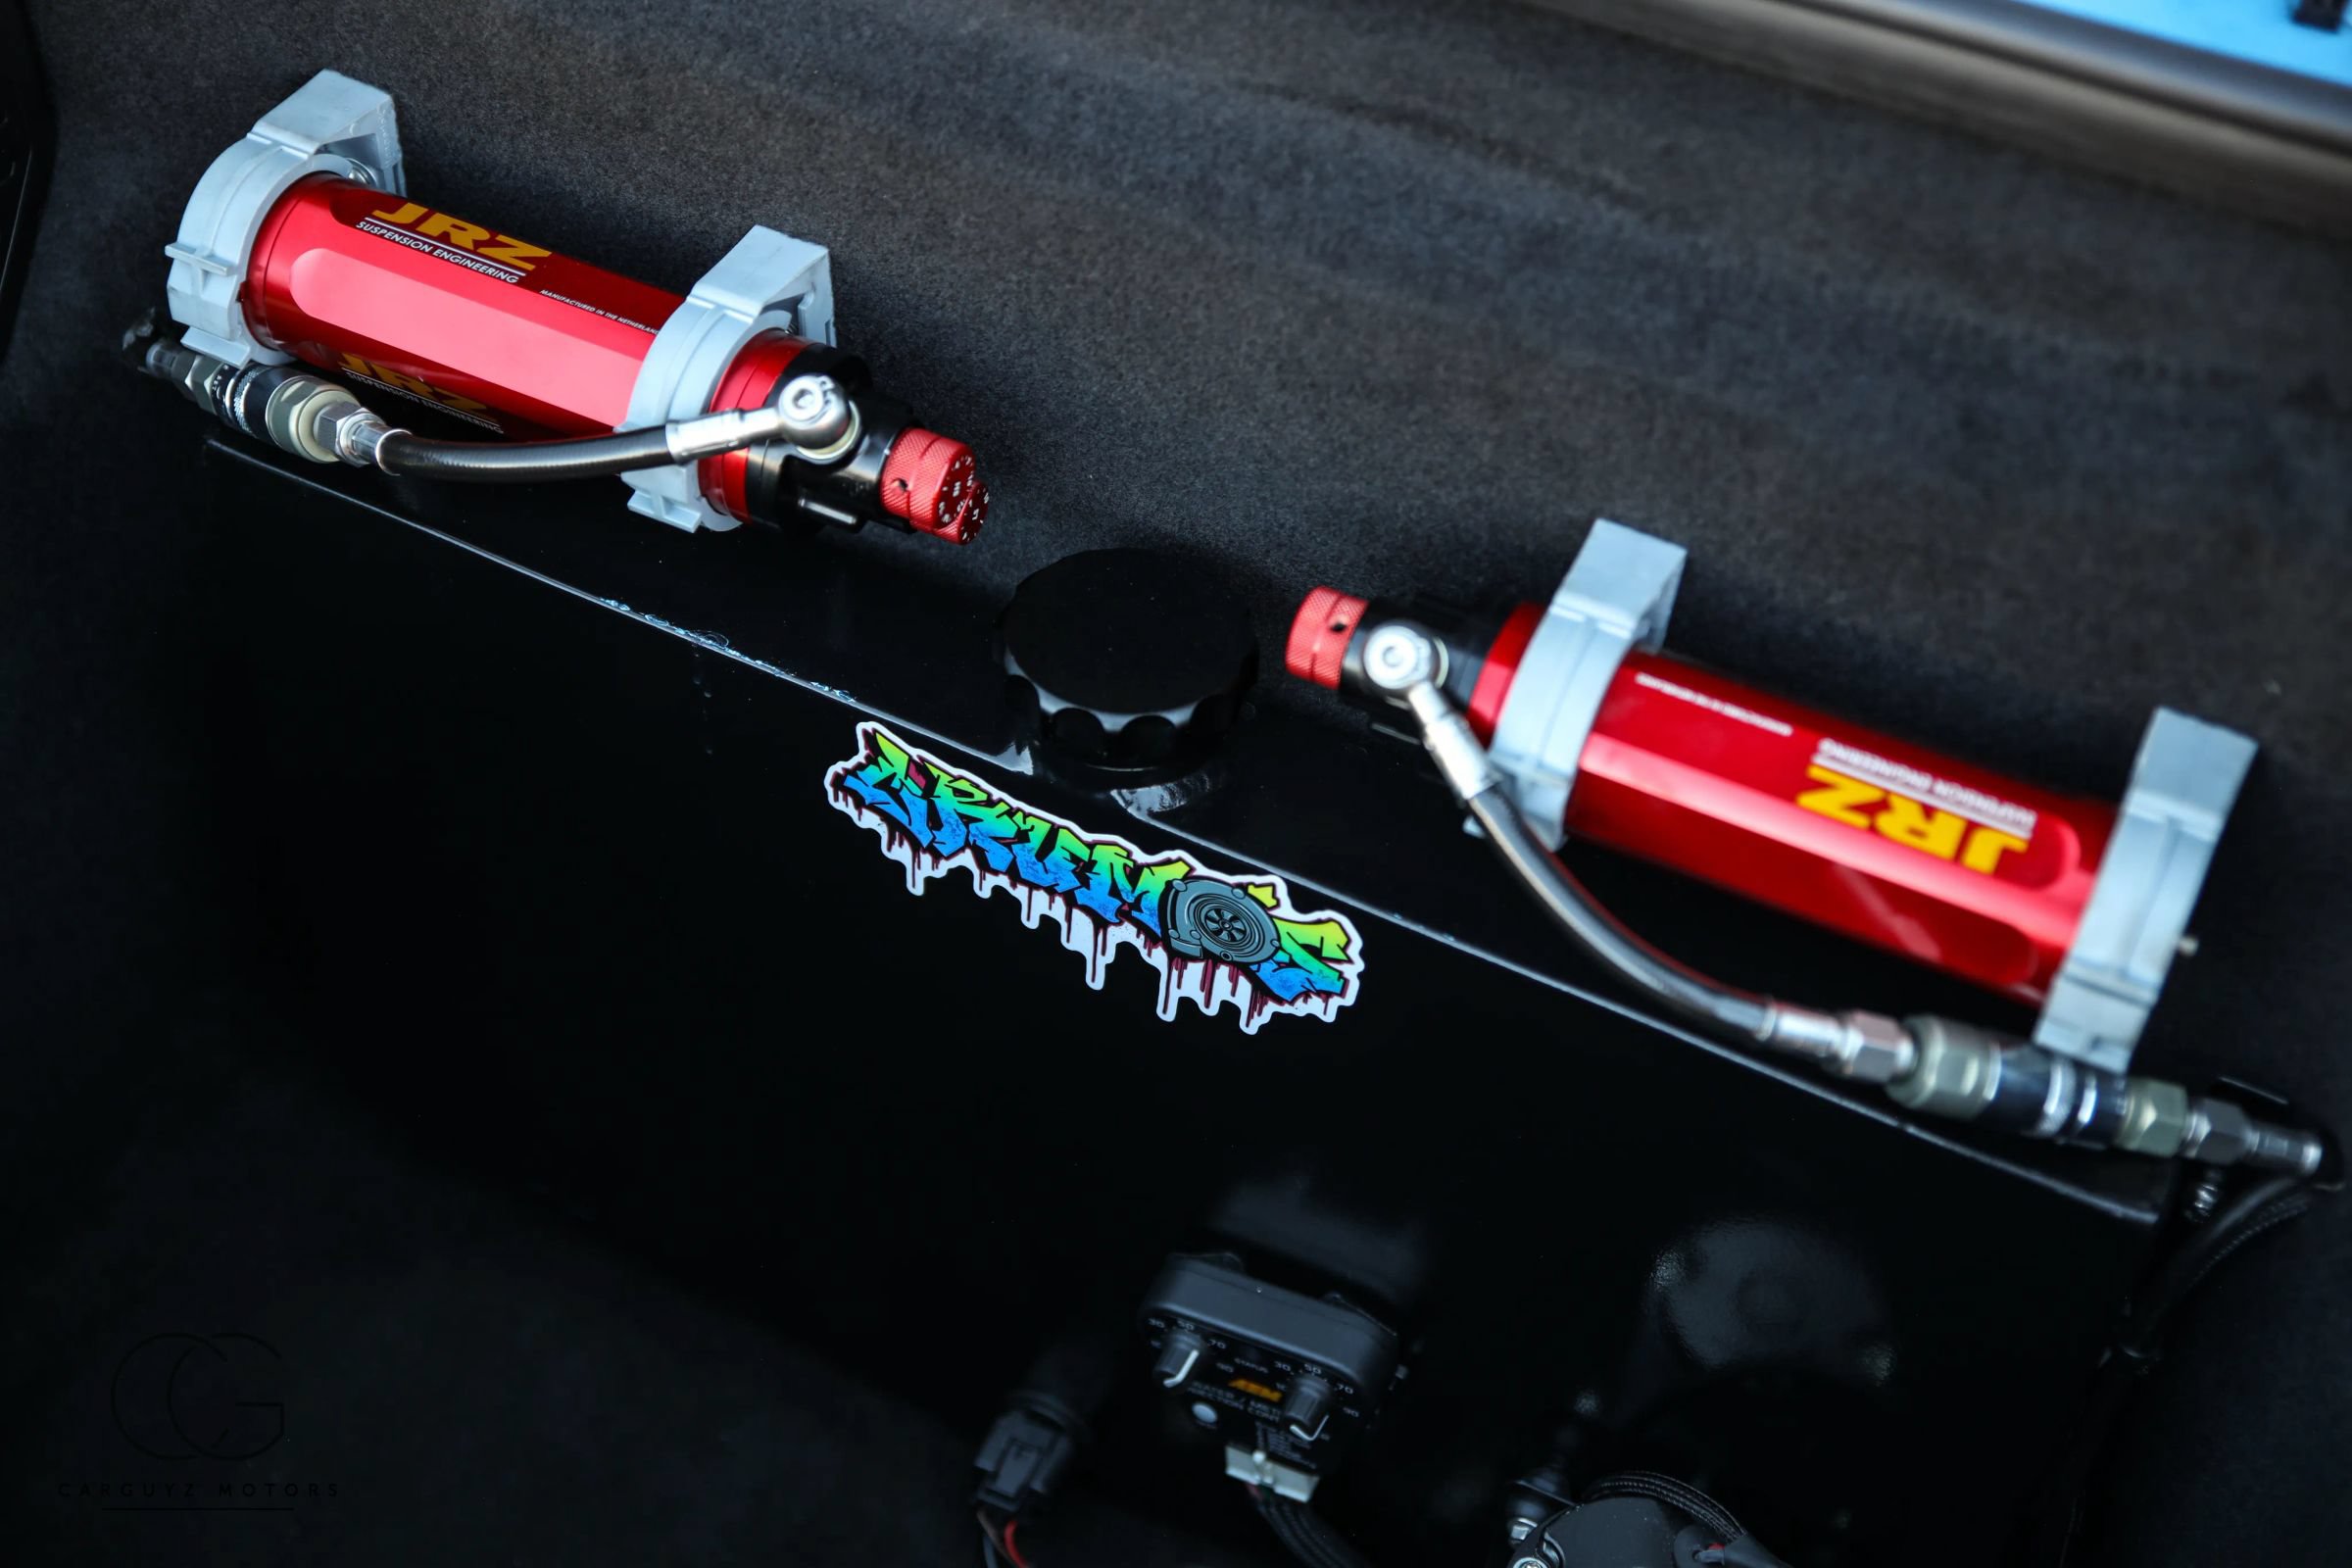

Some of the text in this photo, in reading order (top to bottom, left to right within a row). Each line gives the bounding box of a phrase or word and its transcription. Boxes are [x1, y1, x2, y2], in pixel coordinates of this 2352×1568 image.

[356, 221, 519, 283] SUSPENSION ENGINEERING
[371, 202, 553, 271] JRZ
[539, 289, 596, 313] MANUFACTURED
[1795, 762, 2030, 875] JRZ
[1206, 1339, 1227, 1349] 70
[1274, 1360, 1292, 1372] 30
[1304, 1363, 1322, 1374] 50
[1334, 1383, 1354, 1395] 70
